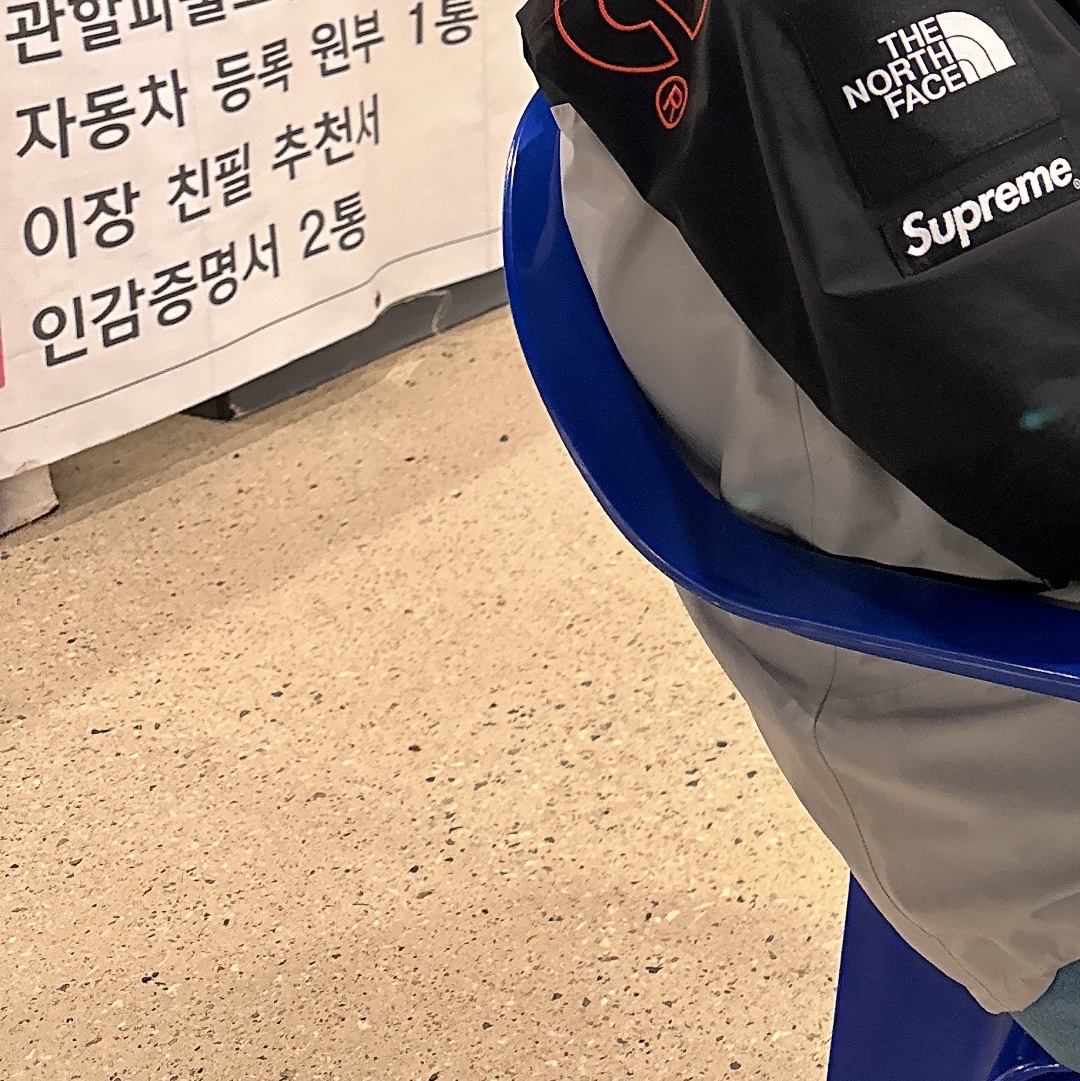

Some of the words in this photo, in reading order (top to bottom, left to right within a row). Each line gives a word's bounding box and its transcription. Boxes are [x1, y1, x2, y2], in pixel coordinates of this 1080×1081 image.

[15, 69, 189, 159] 자동차
[212, 39, 293, 114] 등록
[311, 10, 385, 77] 원부
[841, 40, 954, 110] NORTH
[877, 16, 943, 59] THE
[883, 63, 967, 120] FACE
[24, 182, 141, 260] 이장
[167, 142, 251, 224] 친필
[272, 93, 381, 182] 추천서
[31, 223, 281, 368] 인감증명서
[301, 191, 367, 260] 2통
